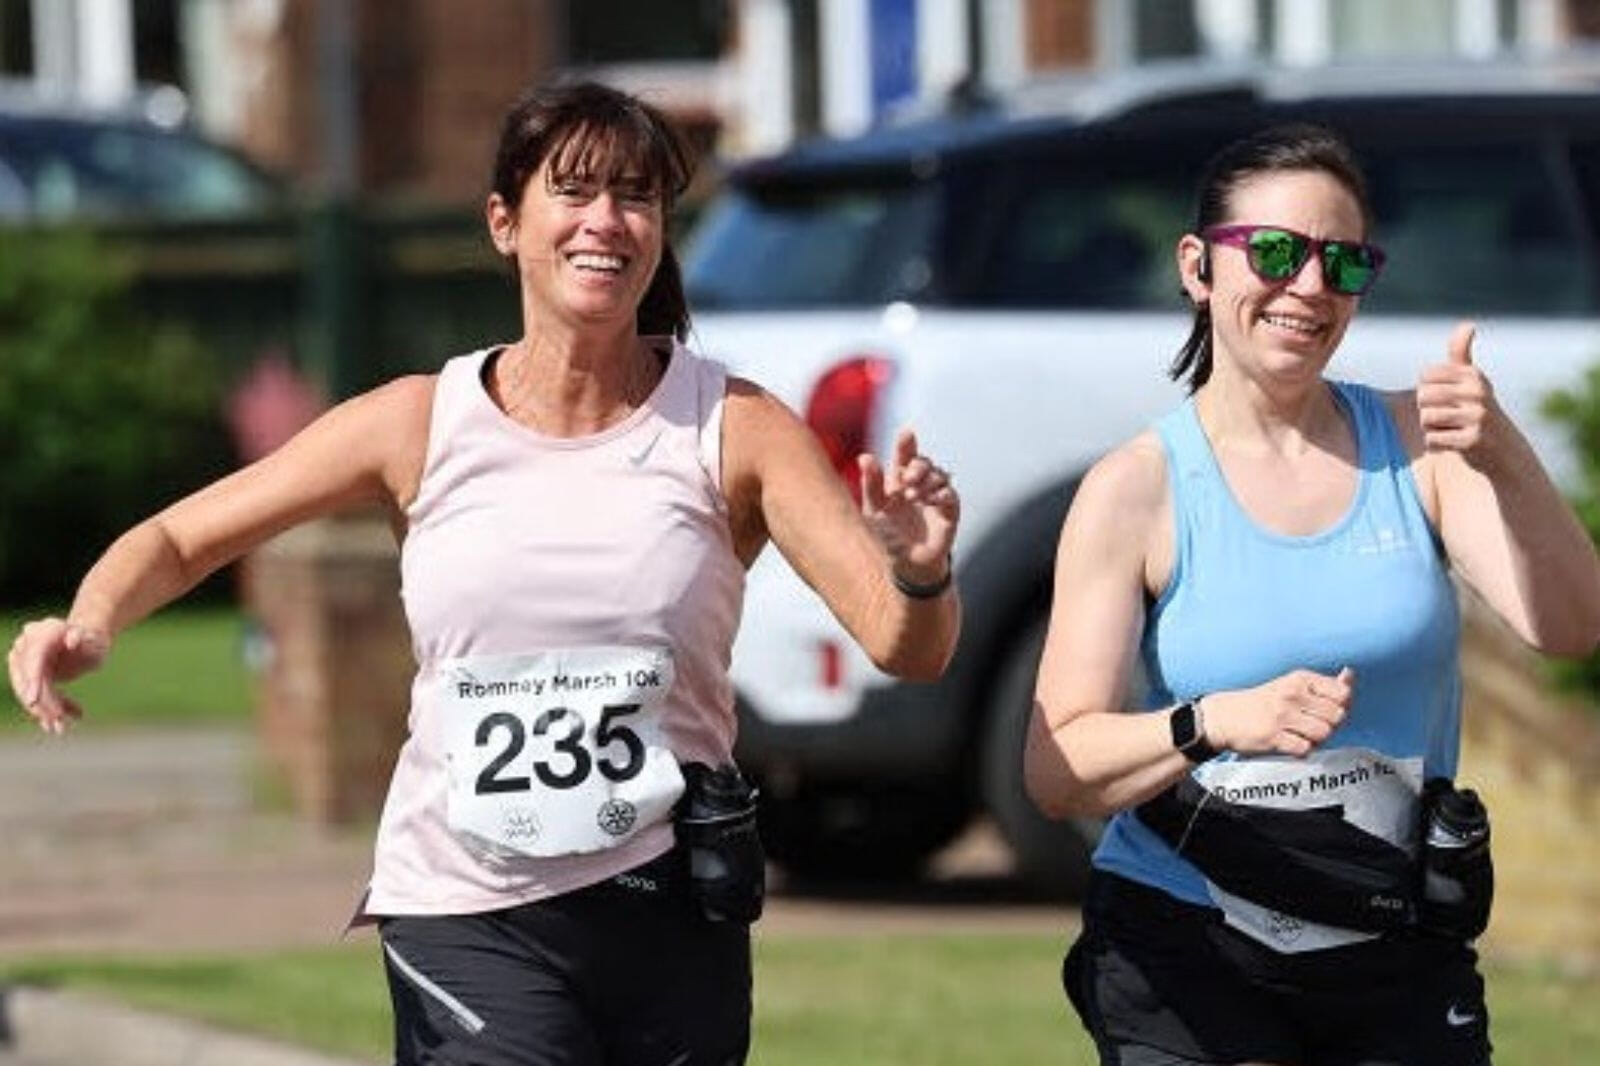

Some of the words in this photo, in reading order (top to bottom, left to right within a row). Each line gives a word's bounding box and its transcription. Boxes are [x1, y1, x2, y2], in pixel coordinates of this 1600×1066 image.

[457, 677, 546, 699] Romney
[553, 672, 616, 693] Marsh
[626, 668, 661, 689] 10k
[475, 703, 644, 796] 235
[1309, 765, 1370, 793] Marsh
